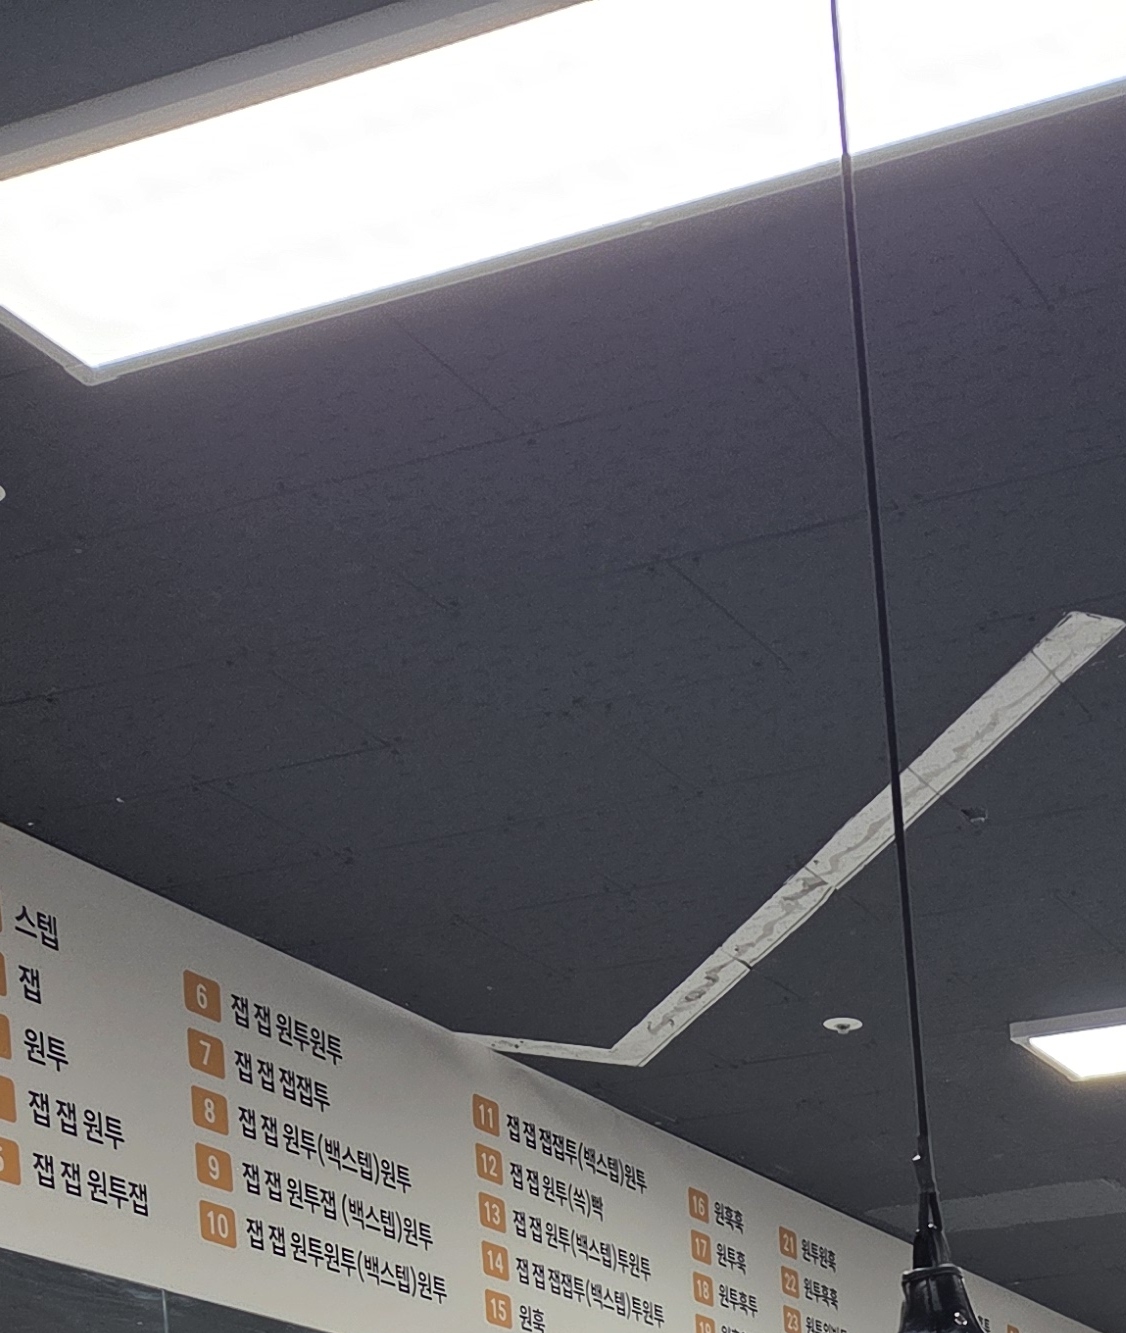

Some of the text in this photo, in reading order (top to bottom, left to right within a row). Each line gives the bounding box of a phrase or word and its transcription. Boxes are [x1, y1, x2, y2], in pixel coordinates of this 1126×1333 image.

[15, 905, 59, 951] 스텝
[18, 964, 42, 1005] 잽
[196, 983, 343, 1065] 6 잽 잽 원투원투
[24, 1028, 69, 1072] 원투
[199, 1039, 330, 1112] 7 잽 잽 잽잽투
[28, 1090, 125, 1150] 잽 잽 원투
[204, 1098, 412, 1193] 8 잽 잽 원투(백스텝)원투
[478, 1103, 648, 1194] 11 잽 잽 잽잽투(백스텝)원투
[33, 1152, 55, 1189] 잽
[60, 1161, 82, 1197] 잽
[87, 1169, 149, 1217] 원투잽
[480, 1152, 498, 1177] 12
[510, 1162, 524, 1191] 잽
[526, 1168, 539, 1197] 잽
[208, 1155, 434, 1251] 9 잽 잽 원투잽 (백스텝)원투
[692, 1195, 744, 1235] 16 원훅훅
[206, 1210, 447, 1304] 10 잽 잽 원투원투(백스텝)원투
[484, 1200, 651, 1281] 13 잽 잽 원투(백스텝)투원투
[695, 1237, 746, 1275] 17 원투훅
[783, 1233, 836, 1273] 21 원투원훅
[487, 1249, 504, 1274] 14
[516, 1257, 529, 1285] 잽
[532, 1263, 545, 1290] 잽
[785, 1272, 838, 1311] 22 원투훅훅
[490, 1298, 507, 1322] 15
[697, 1279, 758, 1318] 18 원투훅투
[787, 1311, 799, 1332] 23
